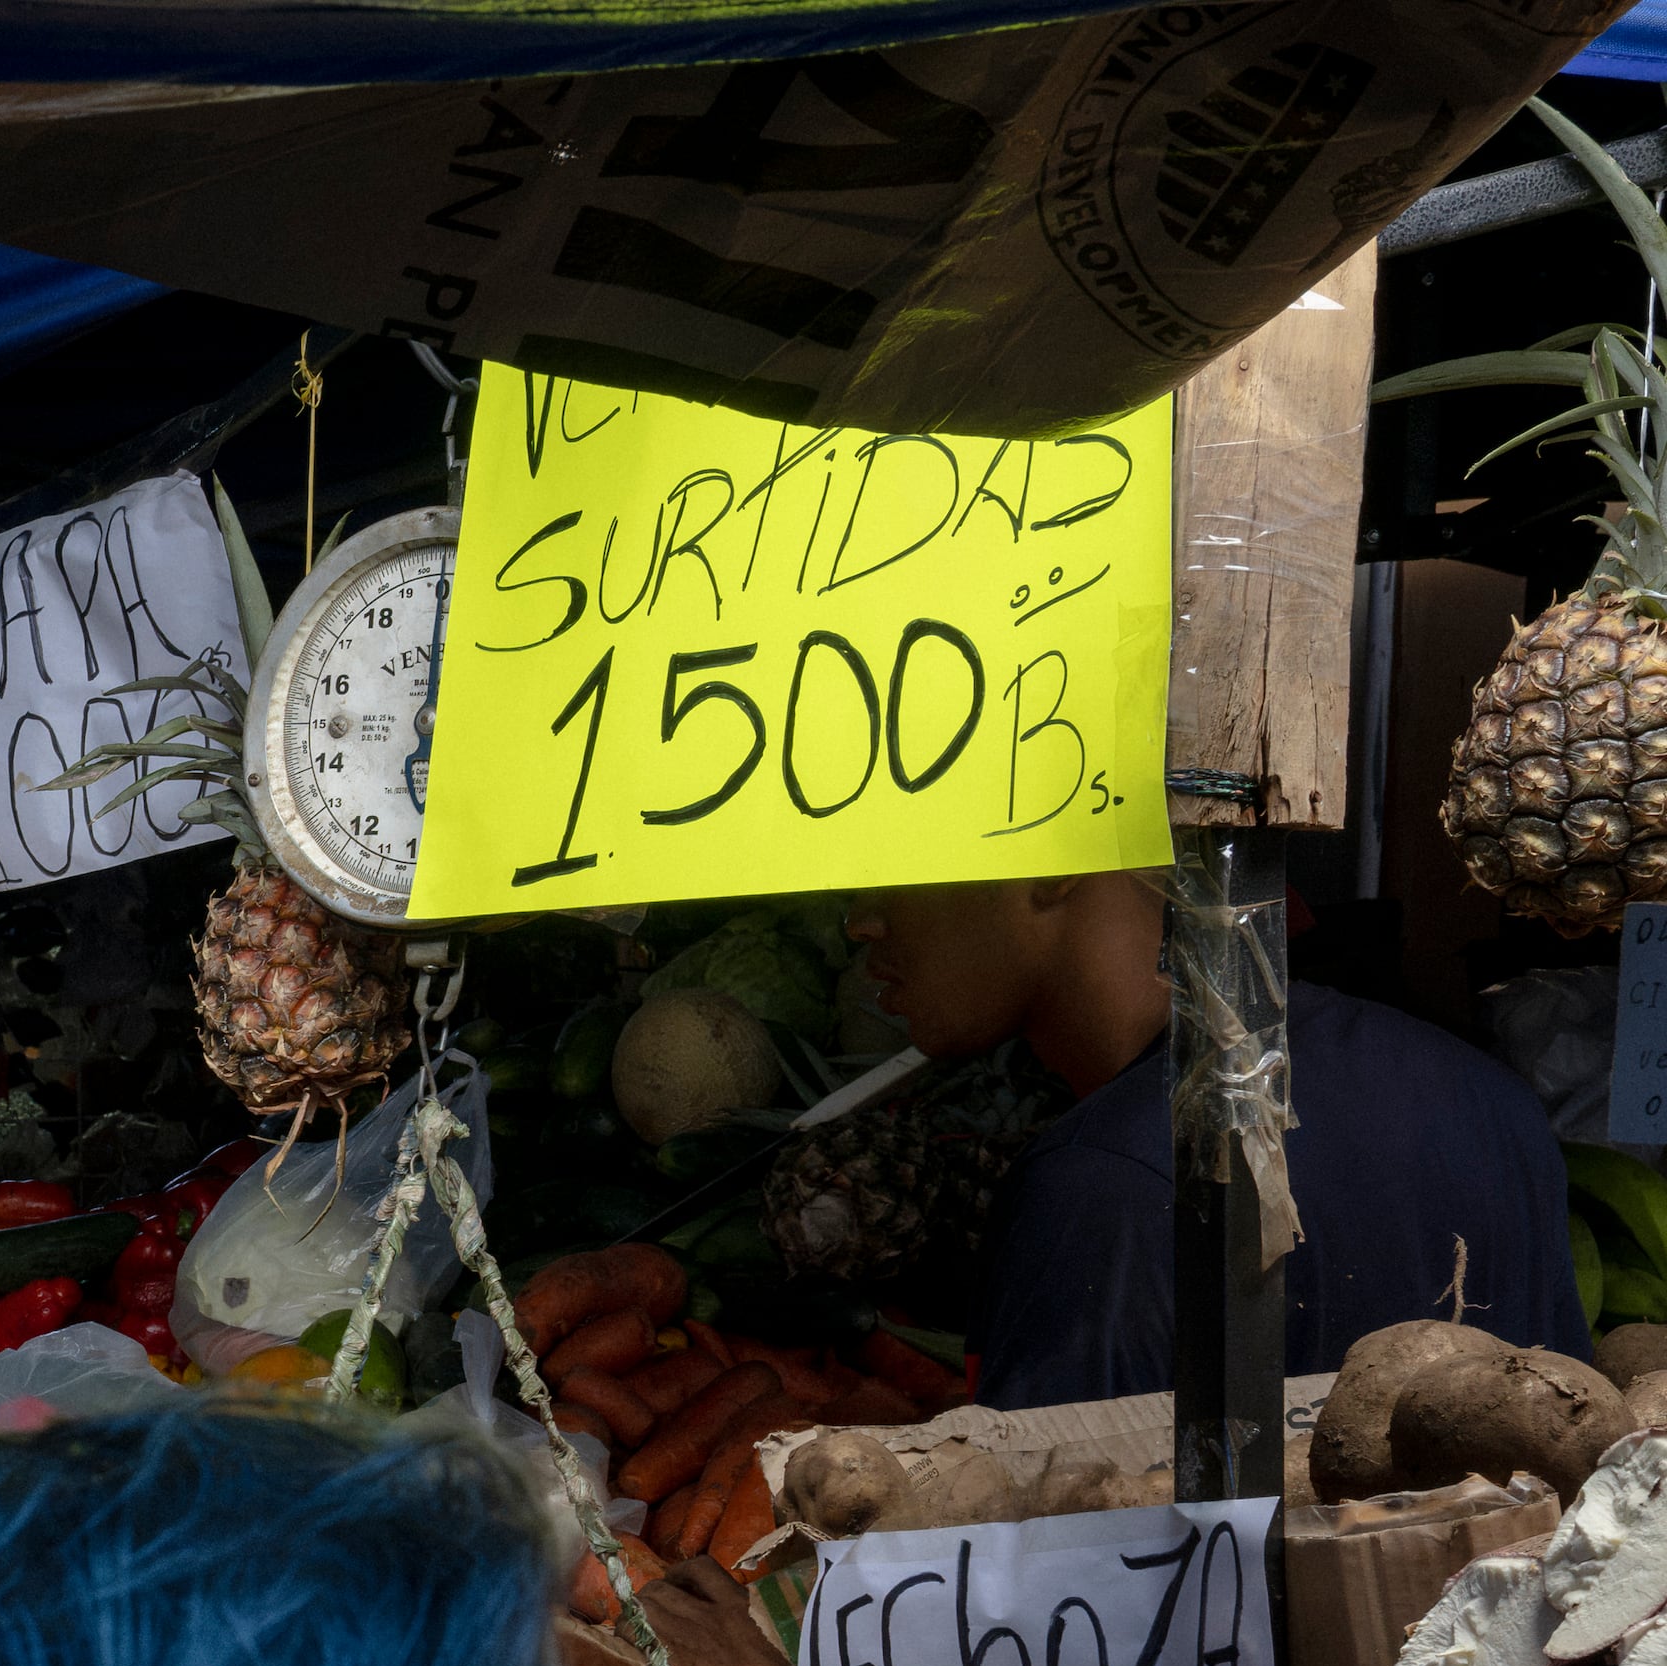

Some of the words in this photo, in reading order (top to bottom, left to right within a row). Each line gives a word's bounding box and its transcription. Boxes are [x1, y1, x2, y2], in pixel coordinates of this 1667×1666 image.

[399, 588, 414, 599] 19
[363, 607, 394, 629] 18
[338, 639, 353, 650] 17
[320, 674, 350, 695] 16
[312, 719, 327, 729] 15
[314, 752, 345, 773] 14
[327, 798, 342, 808] 13
[349, 815, 380, 837] 12
[377, 843, 392, 854] 11
[405, 838, 417, 859] 1
